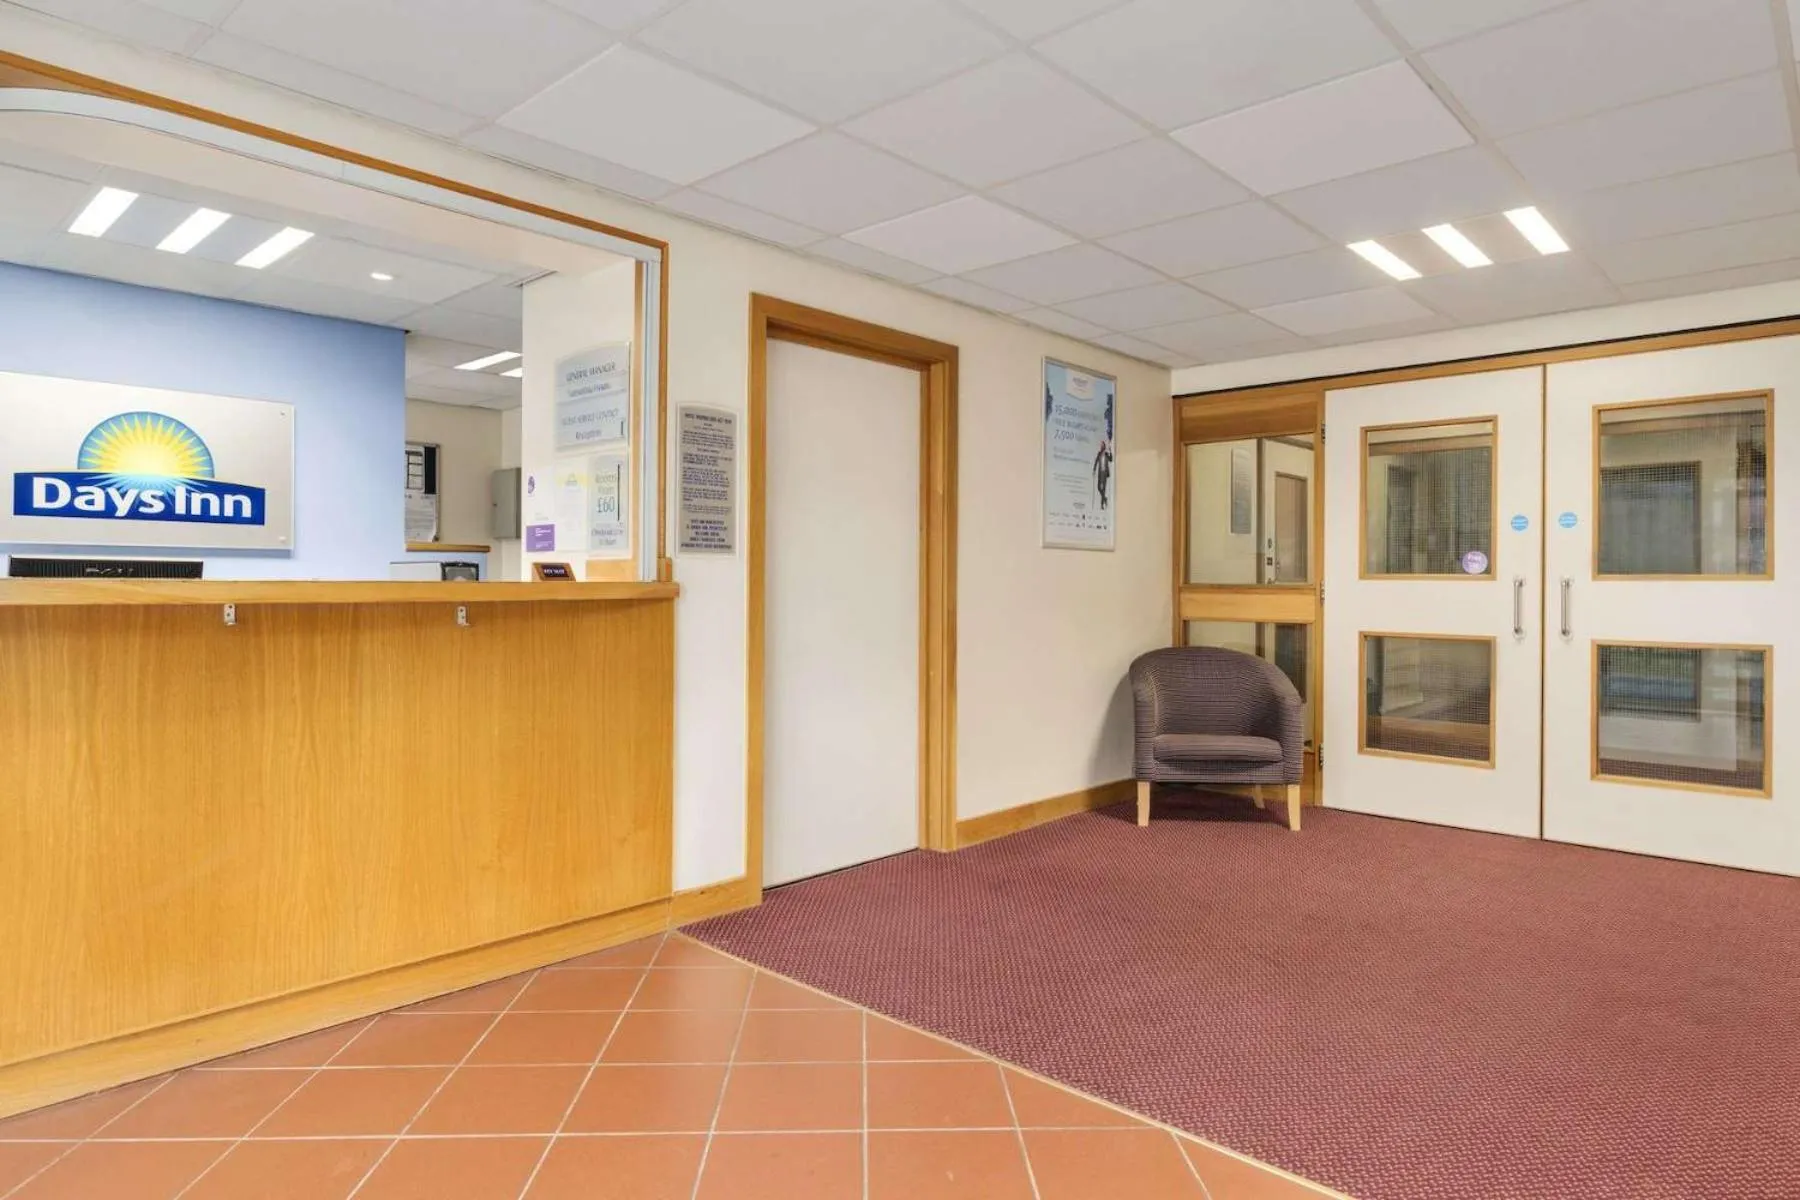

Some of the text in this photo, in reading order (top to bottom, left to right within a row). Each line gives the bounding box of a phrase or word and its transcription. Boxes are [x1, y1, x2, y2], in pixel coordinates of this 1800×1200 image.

[33, 476, 252, 518] Days Inn
[597, 496, 615, 513] £60
